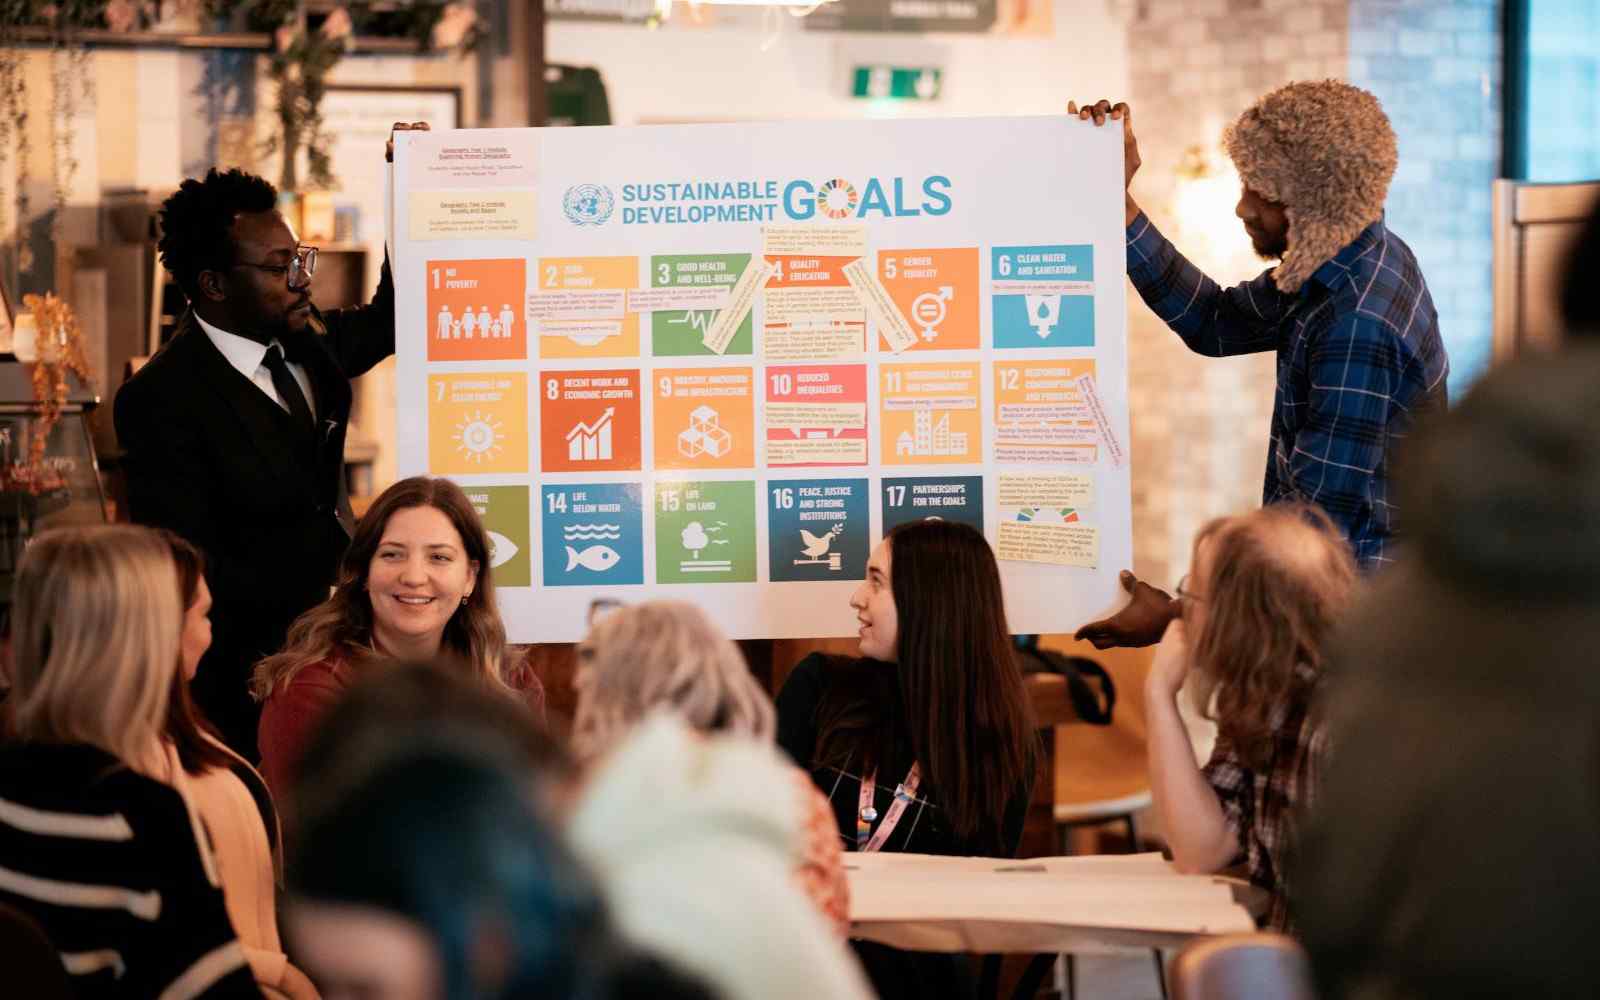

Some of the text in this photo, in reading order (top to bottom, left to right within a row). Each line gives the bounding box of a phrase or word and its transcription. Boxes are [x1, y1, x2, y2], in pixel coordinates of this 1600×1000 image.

[622, 181, 777, 202] SUSTAINABLE
[783, 175, 952, 221] GOALS
[622, 204, 777, 224] DEVELOPMENT
[676, 261, 726, 272] GOOD HEALTH
[885, 257, 897, 279] 5
[999, 255, 1011, 276] 6
[1017, 253, 1066, 264] CLEAN WATER
[432, 268, 440, 289] 1
[545, 266, 558, 287] 2
[658, 263, 671, 285] 3
[677, 273, 737, 284] AND WELL-BEING
[773, 260, 784, 282] 4
[1018, 265, 1077, 276] AND SANITATION
[446, 279, 478, 289] POVERTY
[564, 377, 629, 387] DECENT WORK AND
[659, 377, 672, 397] 9
[770, 373, 792, 396] 10
[884, 369, 902, 392] 11
[1000, 368, 1019, 390] 12
[435, 382, 446, 401] 7
[547, 379, 559, 400] 8
[564, 389, 633, 399] ECONOMIC GROWTH
[573, 492, 587, 501] LIFE
[773, 487, 793, 509] 16
[824, 486, 852, 496] JUSTICE
[886, 485, 906, 507] 17
[912, 485, 966, 494] PARTNERSHIPS
[547, 492, 568, 514] 14
[573, 503, 620, 513] BELOW WATER
[661, 490, 680, 512] 15
[799, 499, 844, 508] AND STRONG
[912, 496, 966, 506] FOR THE GOALS
[799, 511, 847, 521] INSTITUTIONS
